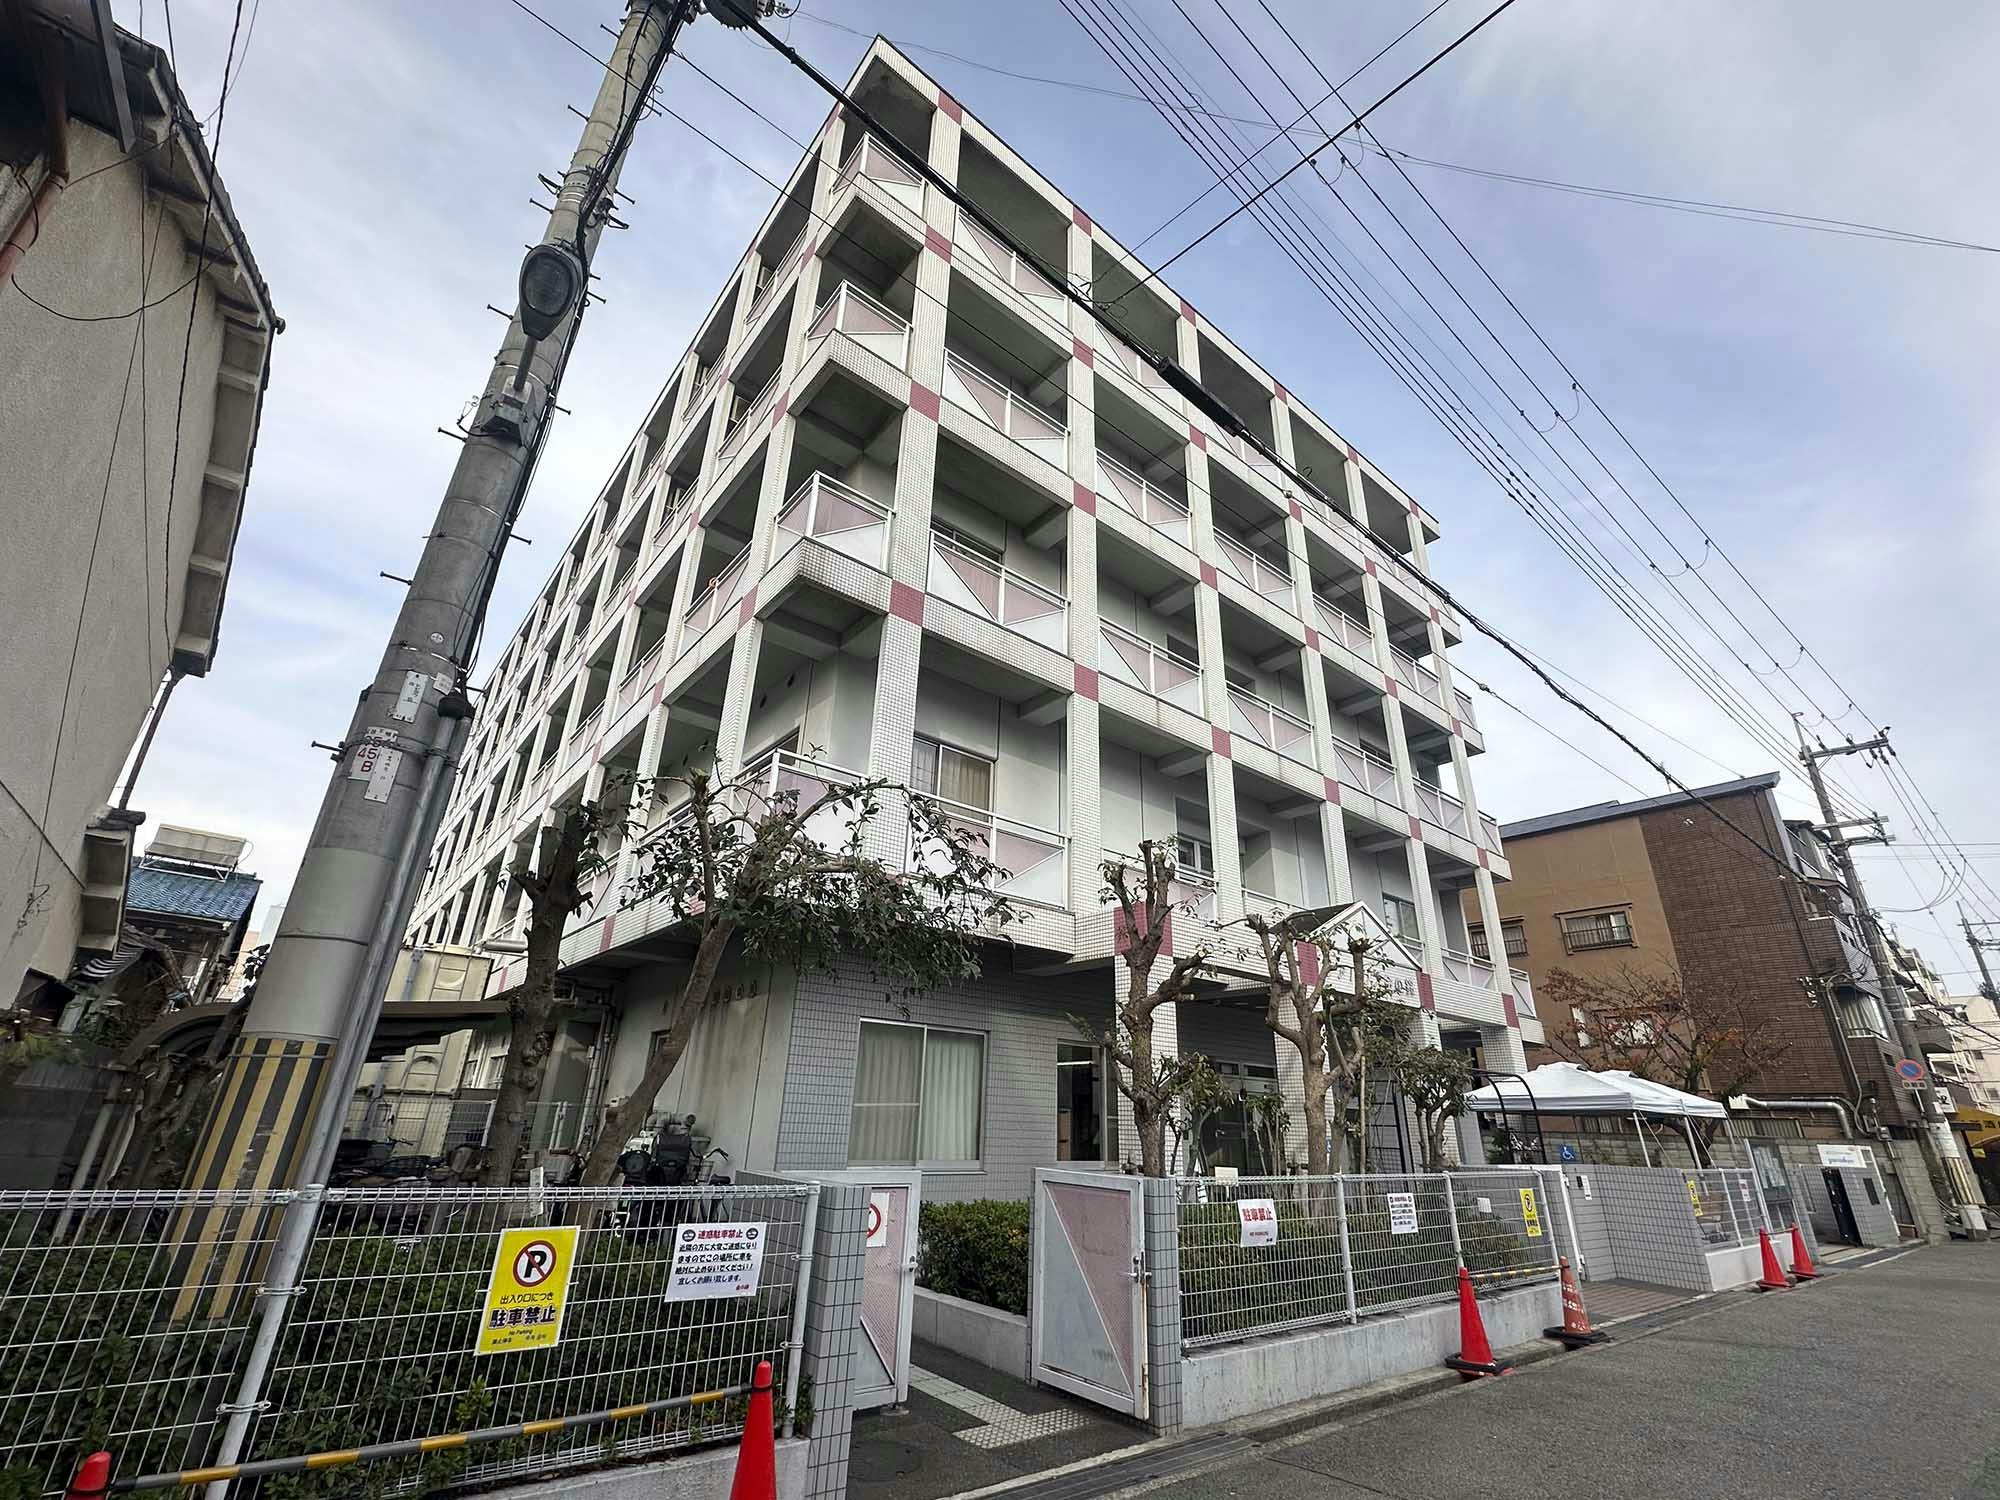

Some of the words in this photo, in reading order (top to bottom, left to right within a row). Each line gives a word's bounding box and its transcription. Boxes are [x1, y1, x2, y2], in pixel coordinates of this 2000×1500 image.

[360, 760, 374, 772] B
[1242, 1207, 1273, 1221] 駐車禁止
[500, 1292, 554, 1304] 出入り口につき
[488, 1305, 556, 1328] 駐車禁止
